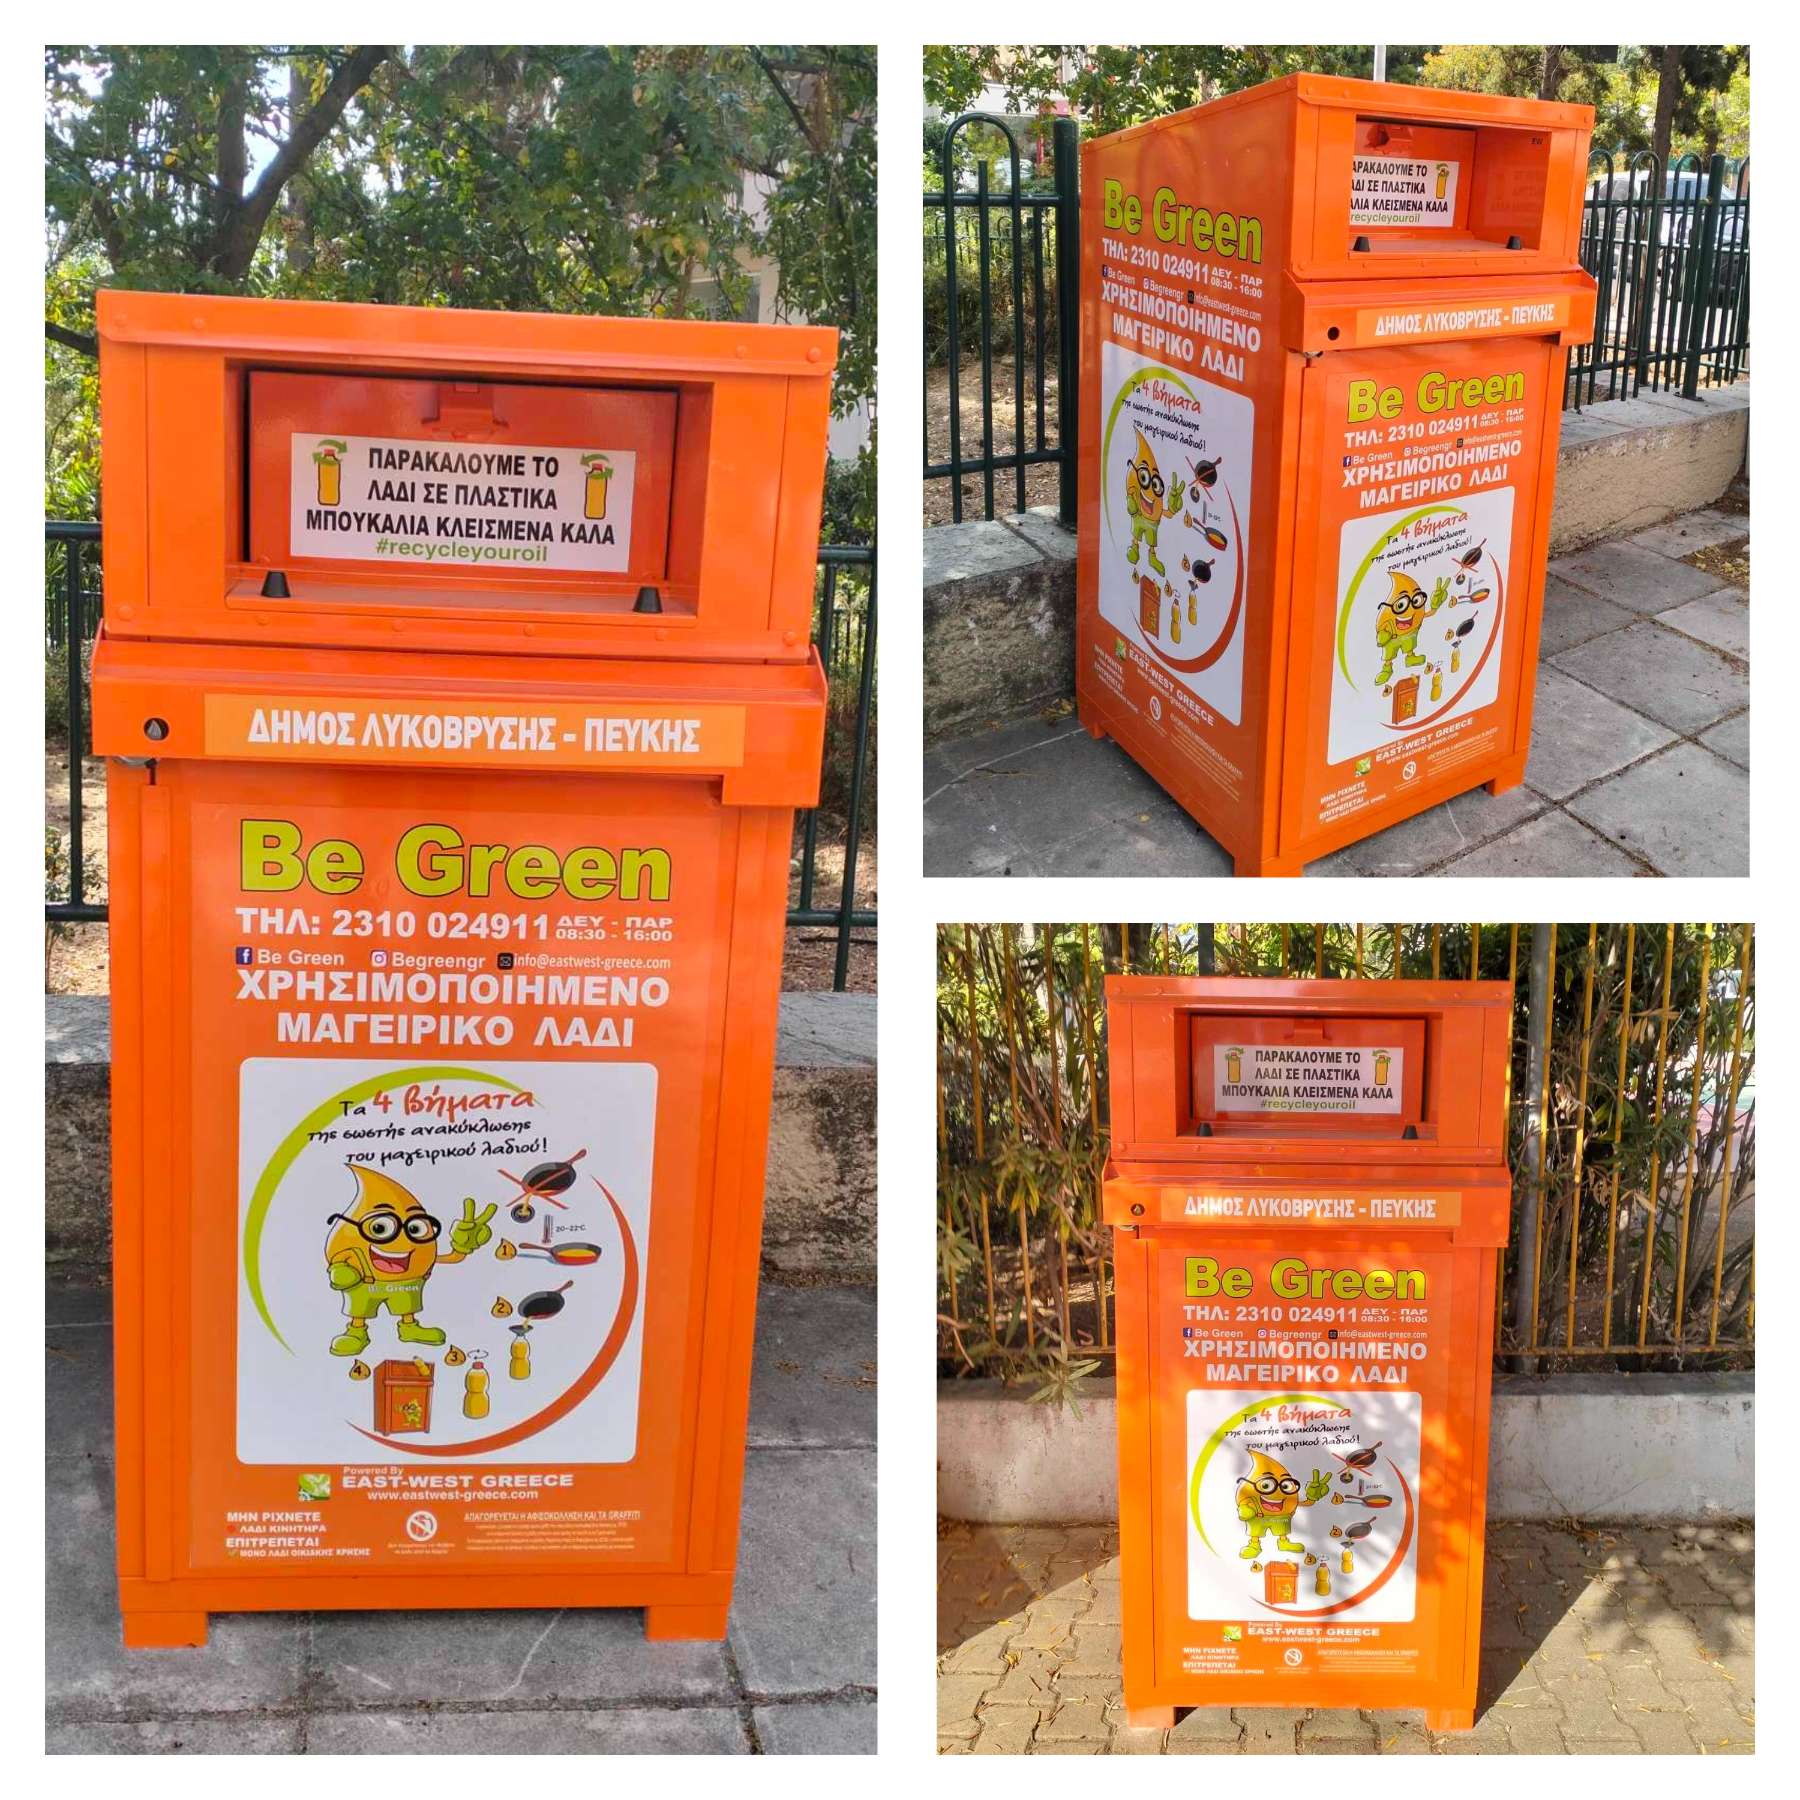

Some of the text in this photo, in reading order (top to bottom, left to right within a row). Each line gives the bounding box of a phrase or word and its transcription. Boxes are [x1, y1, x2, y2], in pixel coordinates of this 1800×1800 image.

[1353, 161, 1427, 177] ΑΡΑΚΑΛΟΥΜΕ ΤΟ
[1368, 180, 1425, 194] ΣΕ ΠΛΑΣΤΙΚΑ
[1372, 200, 1423, 212] ΚΛΕΙΣΜΕΝΑ
[1426, 201, 1448, 213] ΚΑΛΑ
[1104, 178, 1262, 264] Be Green
[1351, 213, 1420, 224] recycleyouroil
[1103, 238, 1208, 284] ΤΗΛ: 2310 024911
[1211, 276, 1262, 298] 08:30 16:00
[1212, 267, 1262, 287] ΔΕΥ ΠΑΡ
[1102, 281, 1261, 352] ΧΡΗΣΙΜΟΠΟΙΗΜΕΝΟ
[1375, 304, 1555, 336] ΔΗΜΟΣ ΛΥΚΟΒΡΥΣΗΣ ΠΕΥΚΗΣ
[1113, 313, 1244, 382] ΜΑΓΕΙΡΙΚΟ ΛΑΔΙ
[1142, 380, 1150, 395] 4
[1347, 370, 1525, 423] Be Green
[1344, 415, 1478, 448] ΤΗΛ: 2310 024911
[369, 447, 559, 477] ΠΑΡΑΚΑΛΟΥΜΕ ΤΟ
[1342, 440, 1521, 488] ΧΡΗΣΙΜΟΠΟΙΗΜΕΝΟ
[1353, 451, 1392, 464] Be Green
[368, 479, 557, 510] ΛΑΔΙ ΣΕ ΠΛΑΣΤΙΚΑ
[1360, 465, 1507, 509] ΜΑΓΕΙΡΙΚΟ ΛΑΔΙ
[307, 510, 615, 545] ΜΠΟΥΚΑΛΙΑ ΚΛΕΙΣΜΕΝΑ ΚΑΛΑ
[1401, 527, 1409, 539] 4
[376, 537, 548, 564] #recycleyouroil
[248, 709, 355, 746] ΔΗΜΟΣ
[362, 713, 556, 750] ΛΥΚΟΒΡΥΣΗΣ
[585, 718, 700, 753] ΠΕΥΚΗΣ
[1436, 717, 1473, 738] GREECE
[240, 819, 671, 901] Be Green
[236, 908, 548, 940] ΤΗΛ: 2310 024911
[556, 915, 672, 928] ΔΕΥ ΠΑΡ
[556, 929, 672, 942] 08:30 16:00
[257, 949, 344, 965] Be Green
[392, 951, 485, 972] Begreengr
[514, 953, 670, 970] info@eastwest-greece.com
[236, 969, 669, 1007] ΧΡΗΣΙΜΟΠΟΙΗΜΕΝΟ
[278, 1012, 633, 1047] ΜΑΓΕΙΡΙΚΟ ΛΑΔΙ
[1255, 1050, 1361, 1063] ΠΑΡΑΚΑΛΟΥΜΕ ΤΟ
[1255, 1068, 1360, 1081] ΛΑΔΙ ΣΕ ΠΛΑΣΤΙΚΑ
[1222, 1085, 1393, 1099] ΜΠΟΥΚΑΛΙΑ ΚΛΕΙΣΜΕΝΑ ΚΑΛΑ
[340, 1084, 535, 1125] Τα 4 βήματα
[1260, 1100, 1356, 1111] #recycleyouroil
[346, 1137, 547, 1167] του μαγειρικού λαδιού!
[1184, 1196, 1436, 1218] ΔΗΜΟΣ ΛΥΚΟΒΡΥΣΗΣ ΠΕΥΚΗΣ
[1185, 1257, 1426, 1300] Be Green
[1183, 1305, 1356, 1322] ΤΗΛ: 2310 024911
[1195, 1329, 1243, 1338] Be Green
[450, 1350, 458, 1361] 3
[1183, 1340, 1427, 1360] ΧΡΗΣΙΜΟΠΟΙΗΜΕΝΟ
[353, 1365, 362, 1376] 4
[1206, 1364, 1407, 1384] ΜΑΓΕΙΡΙΚΟ ΛΑΔΙ
[1260, 1409, 1270, 1421] 4
[1278, 1404, 1352, 1426] βήματα
[343, 1474, 573, 1488] EAST-WEST GREECE
[390, 1467, 403, 1476] By
[368, 1489, 538, 1502] www.eastwest-greece.com
[227, 1512, 320, 1522] ΜΗΝ ΡΙΧΝΕΤΕ
[226, 1537, 319, 1547] ΕΠΙΤΡΕΠΕΤΑΙ
[1248, 1628, 1380, 1637] EAST-WEST GREECE
